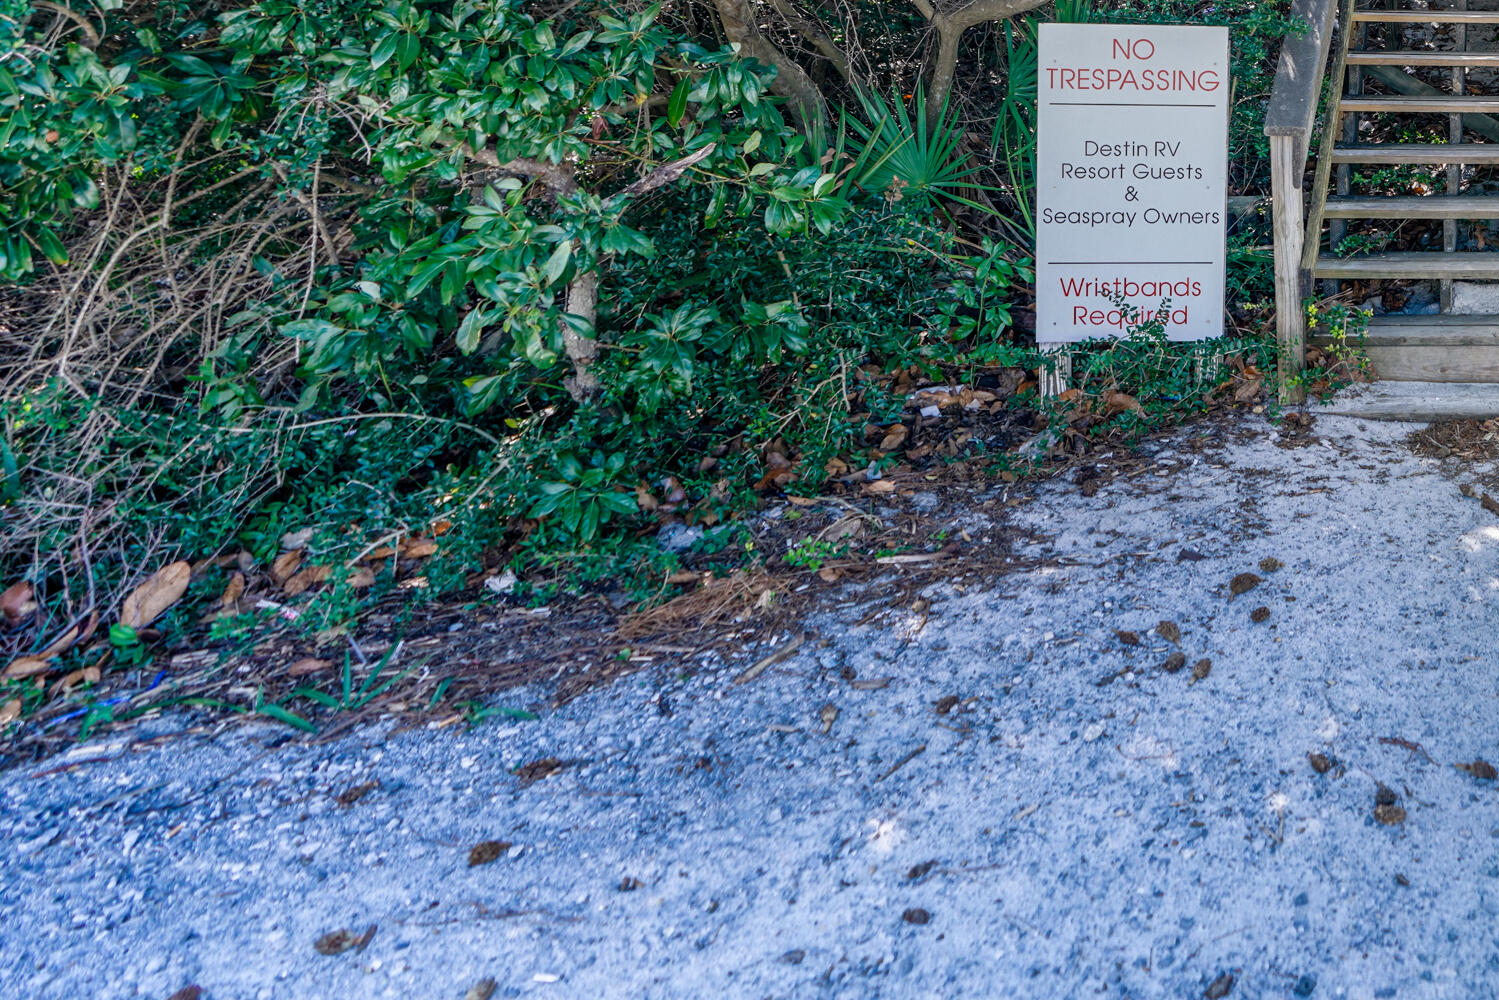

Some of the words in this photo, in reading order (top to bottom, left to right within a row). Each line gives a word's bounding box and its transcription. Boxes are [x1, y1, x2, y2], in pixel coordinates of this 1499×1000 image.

[1113, 39, 1154, 60] NO
[1046, 68, 1220, 91] TRESPASSING
[1085, 141, 1147, 156] Destin
[1155, 142, 1180, 156] RV
[1062, 163, 1125, 179] Resort
[1133, 164, 1202, 179] Guests
[1125, 186, 1139, 201] &
[1043, 208, 1136, 227] Seaspray
[1144, 208, 1219, 224] Owners
[1060, 278, 1201, 296] Wristbands
